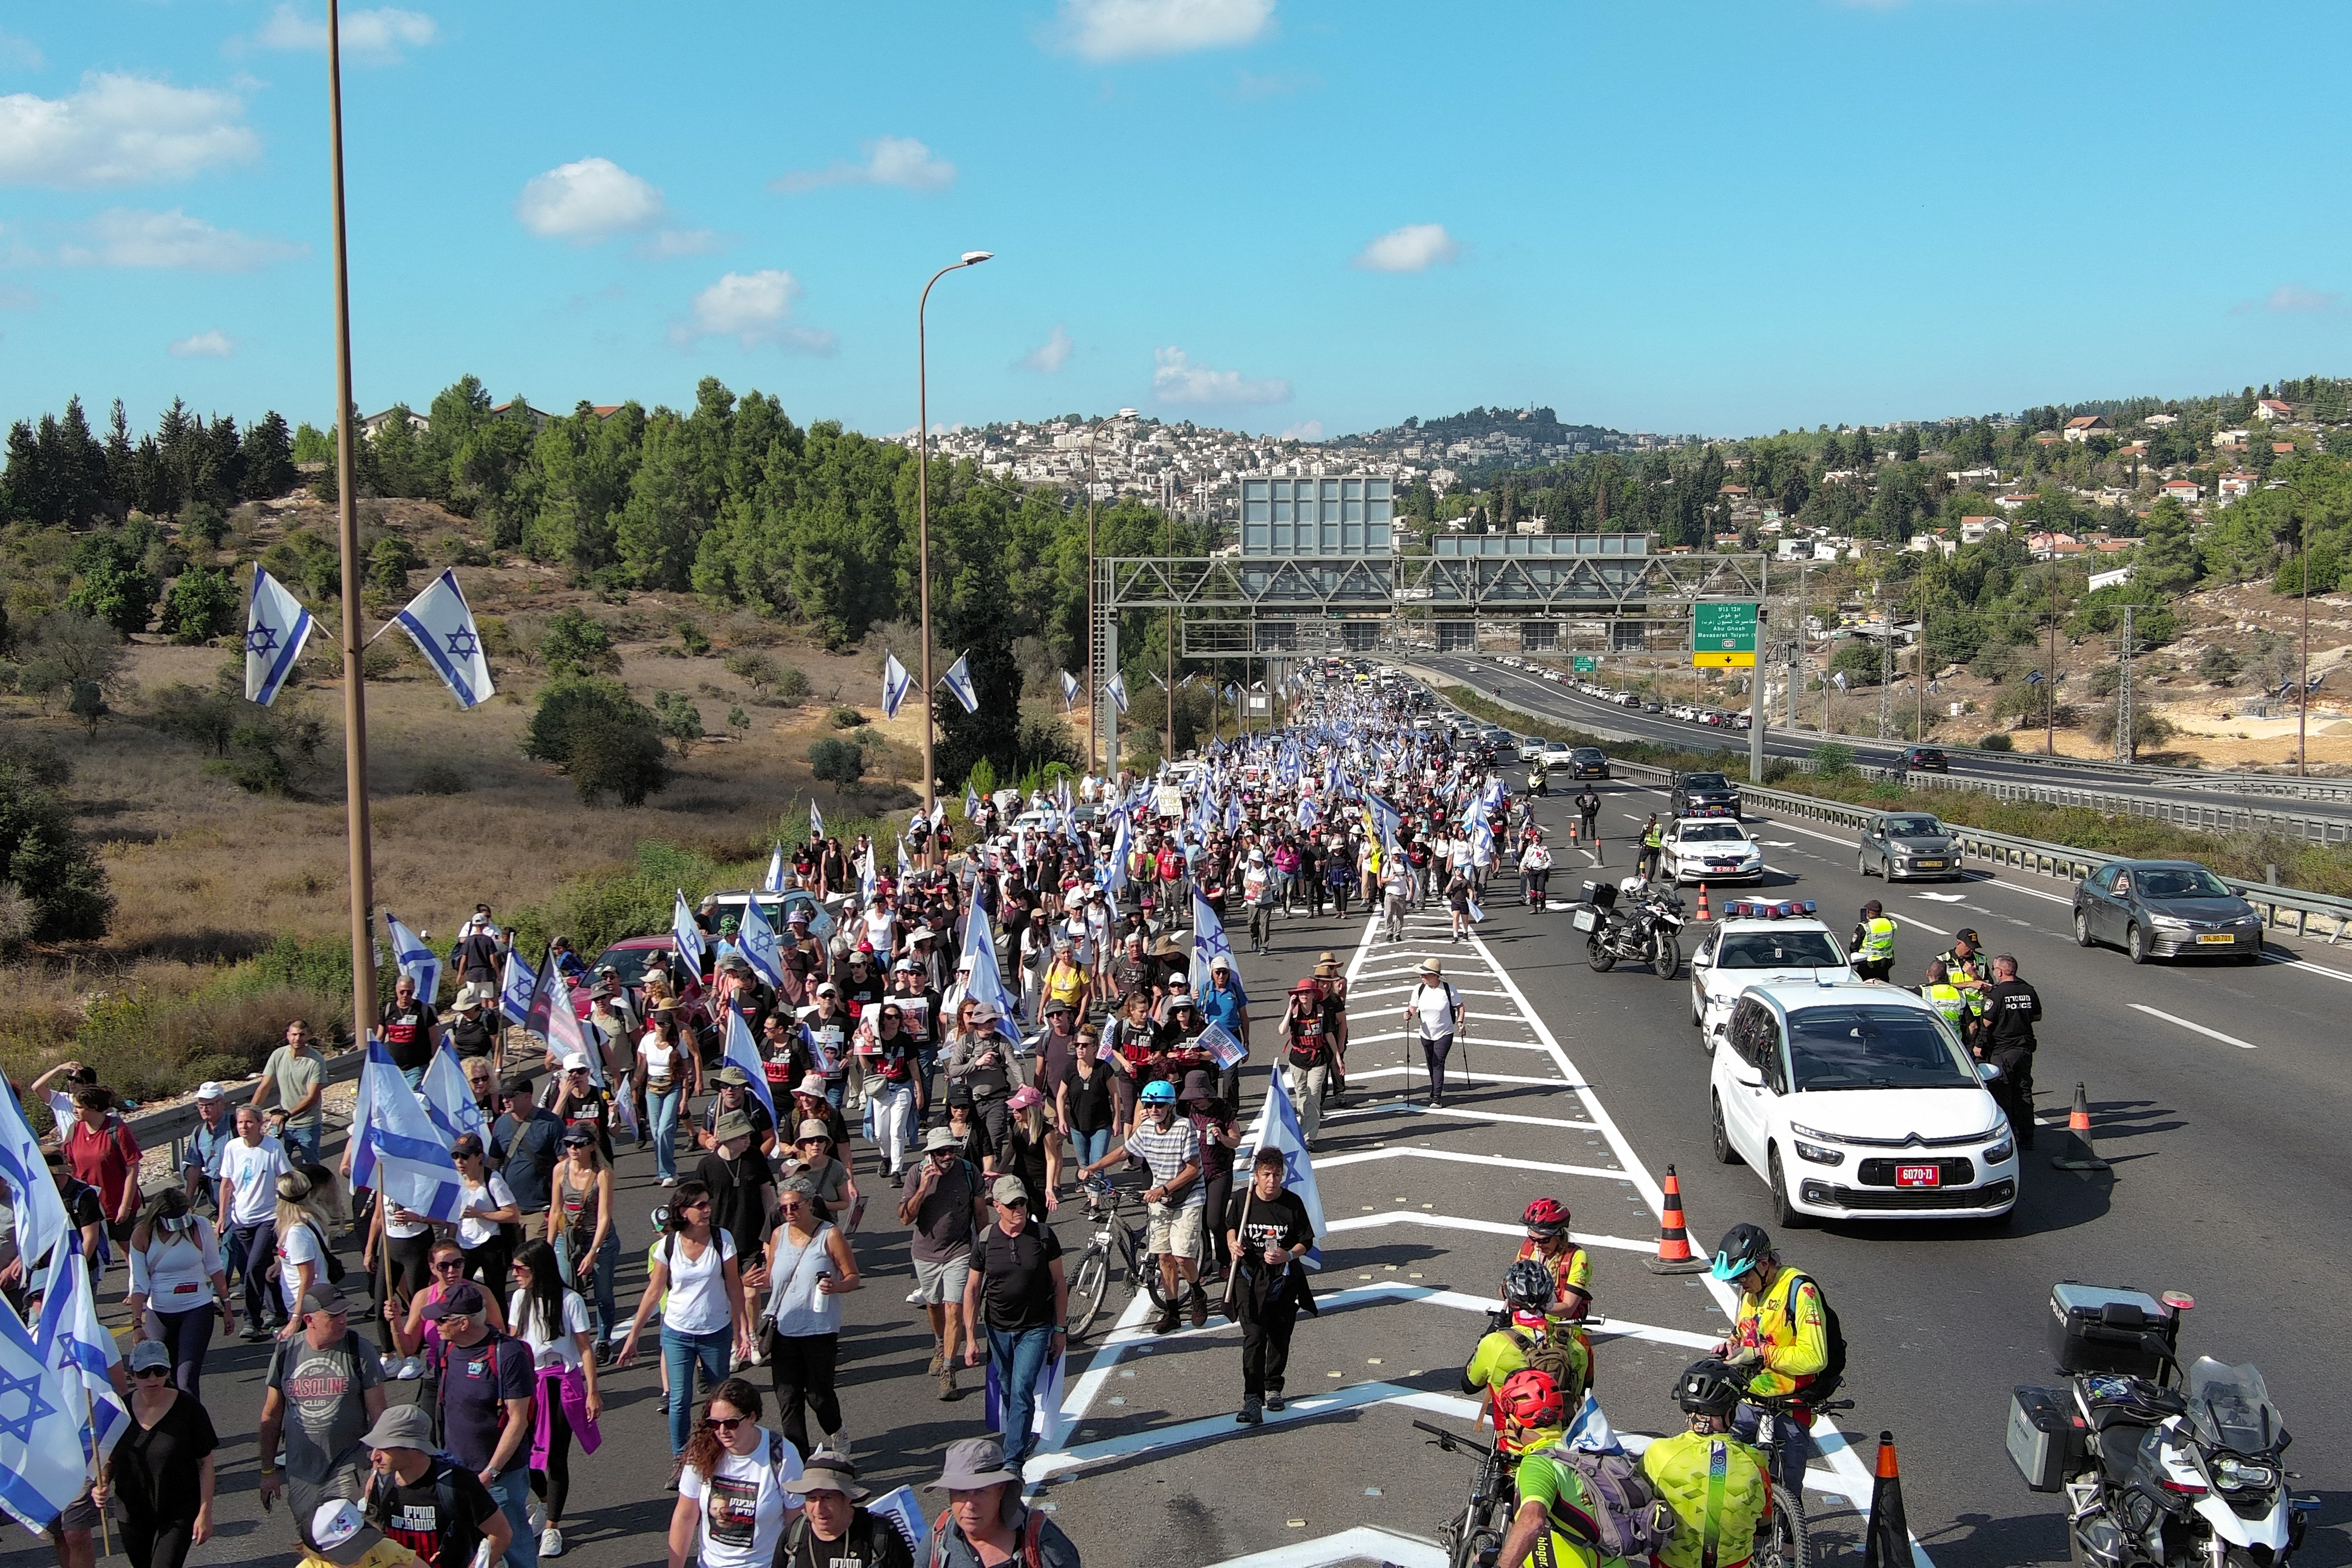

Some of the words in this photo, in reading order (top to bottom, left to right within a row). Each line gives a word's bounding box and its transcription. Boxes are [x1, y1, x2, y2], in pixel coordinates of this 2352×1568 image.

[2004, 995, 2031, 1003] משטרה
[2049, 1296, 2067, 1328] POLICE
[308, 1367, 325, 1376] The
[286, 1377, 349, 1396] GASOLINE
[1710, 1455, 1725, 1484] B2G
